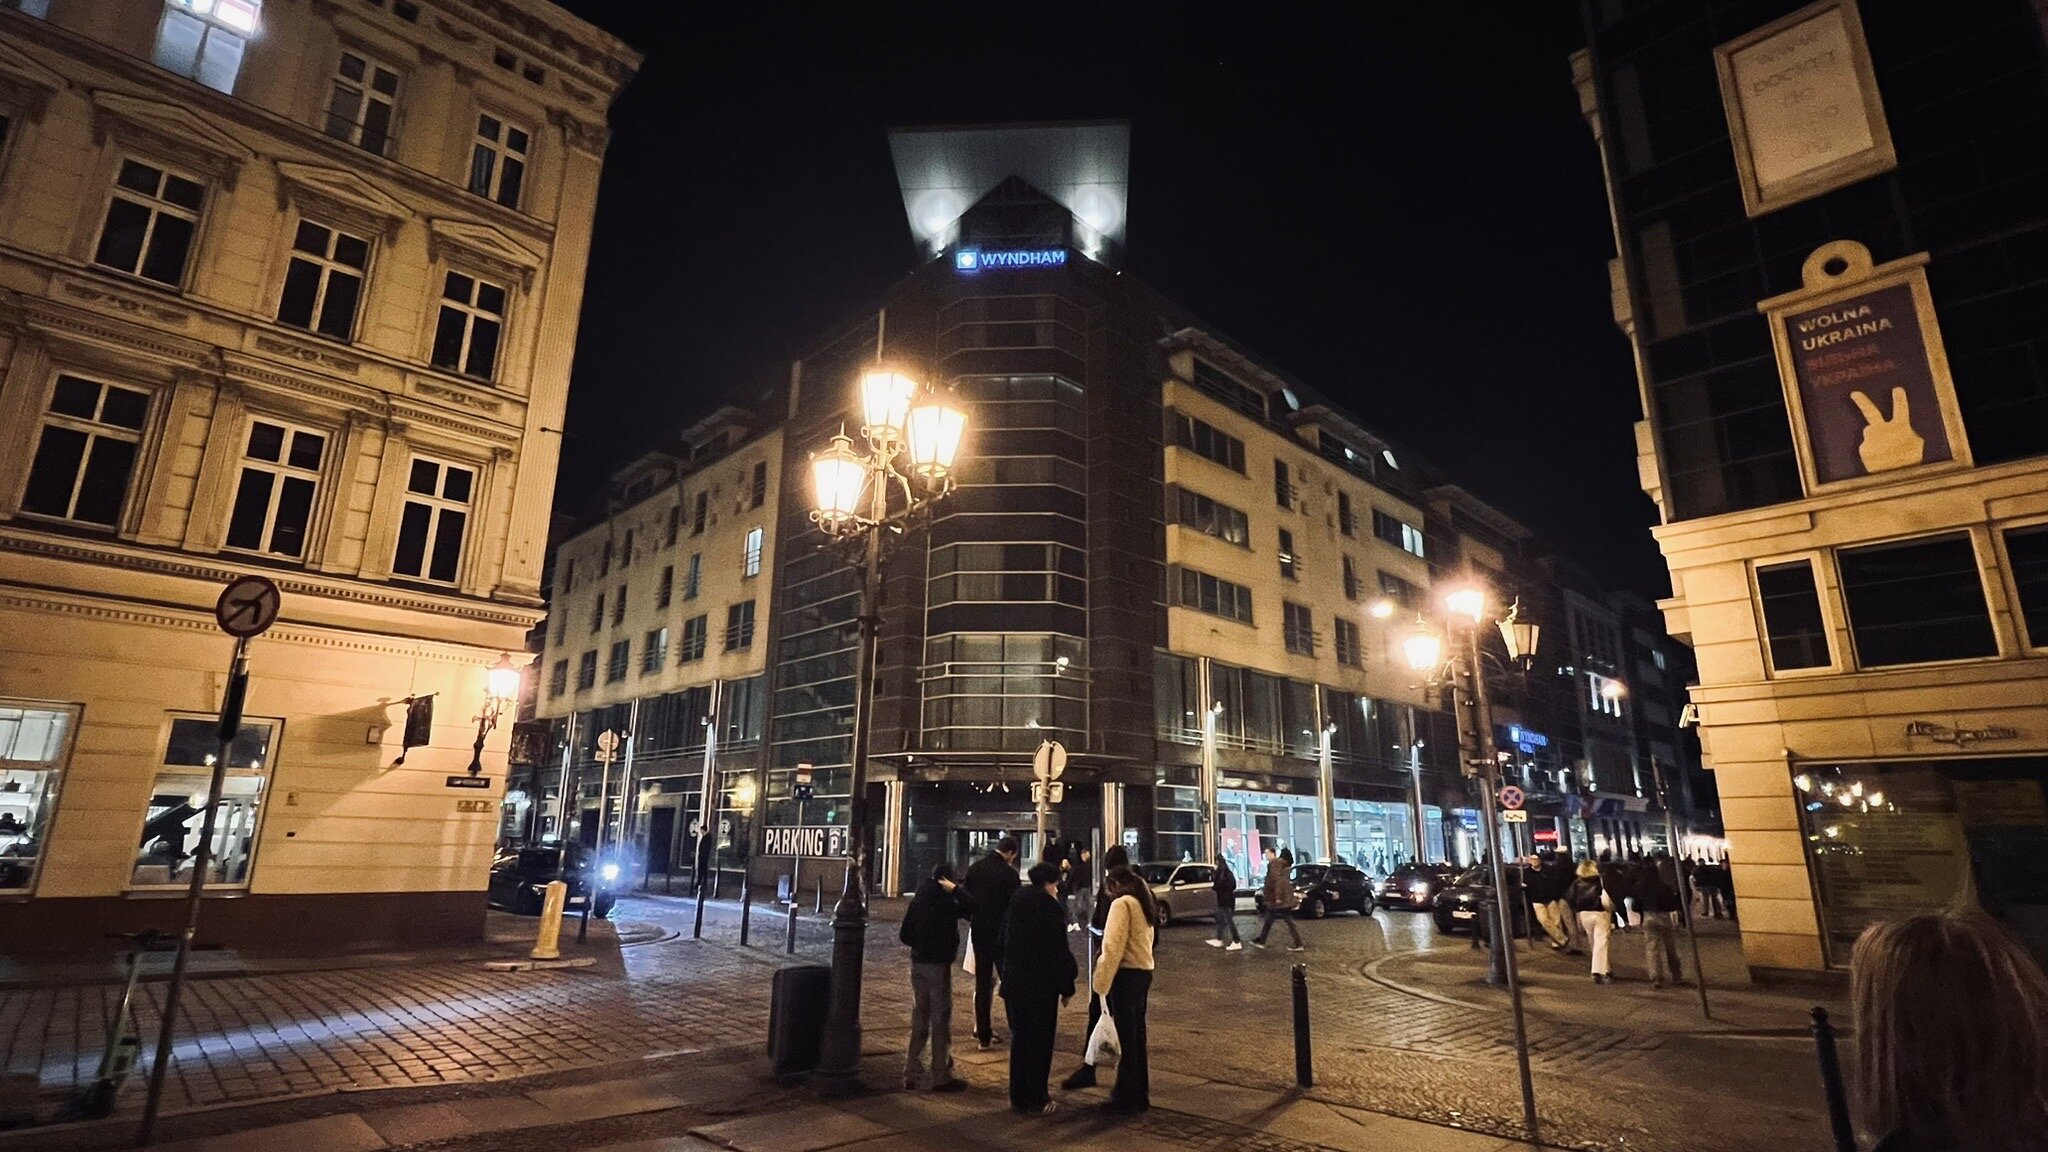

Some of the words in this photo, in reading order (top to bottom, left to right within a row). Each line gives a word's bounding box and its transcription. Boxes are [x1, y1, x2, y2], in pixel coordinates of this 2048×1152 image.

[981, 250, 1065, 266] WYNDHAM
[1798, 304, 1872, 333] WOLNA
[1802, 317, 1893, 351] UKRAINA
[765, 828, 824, 856] PARKING
